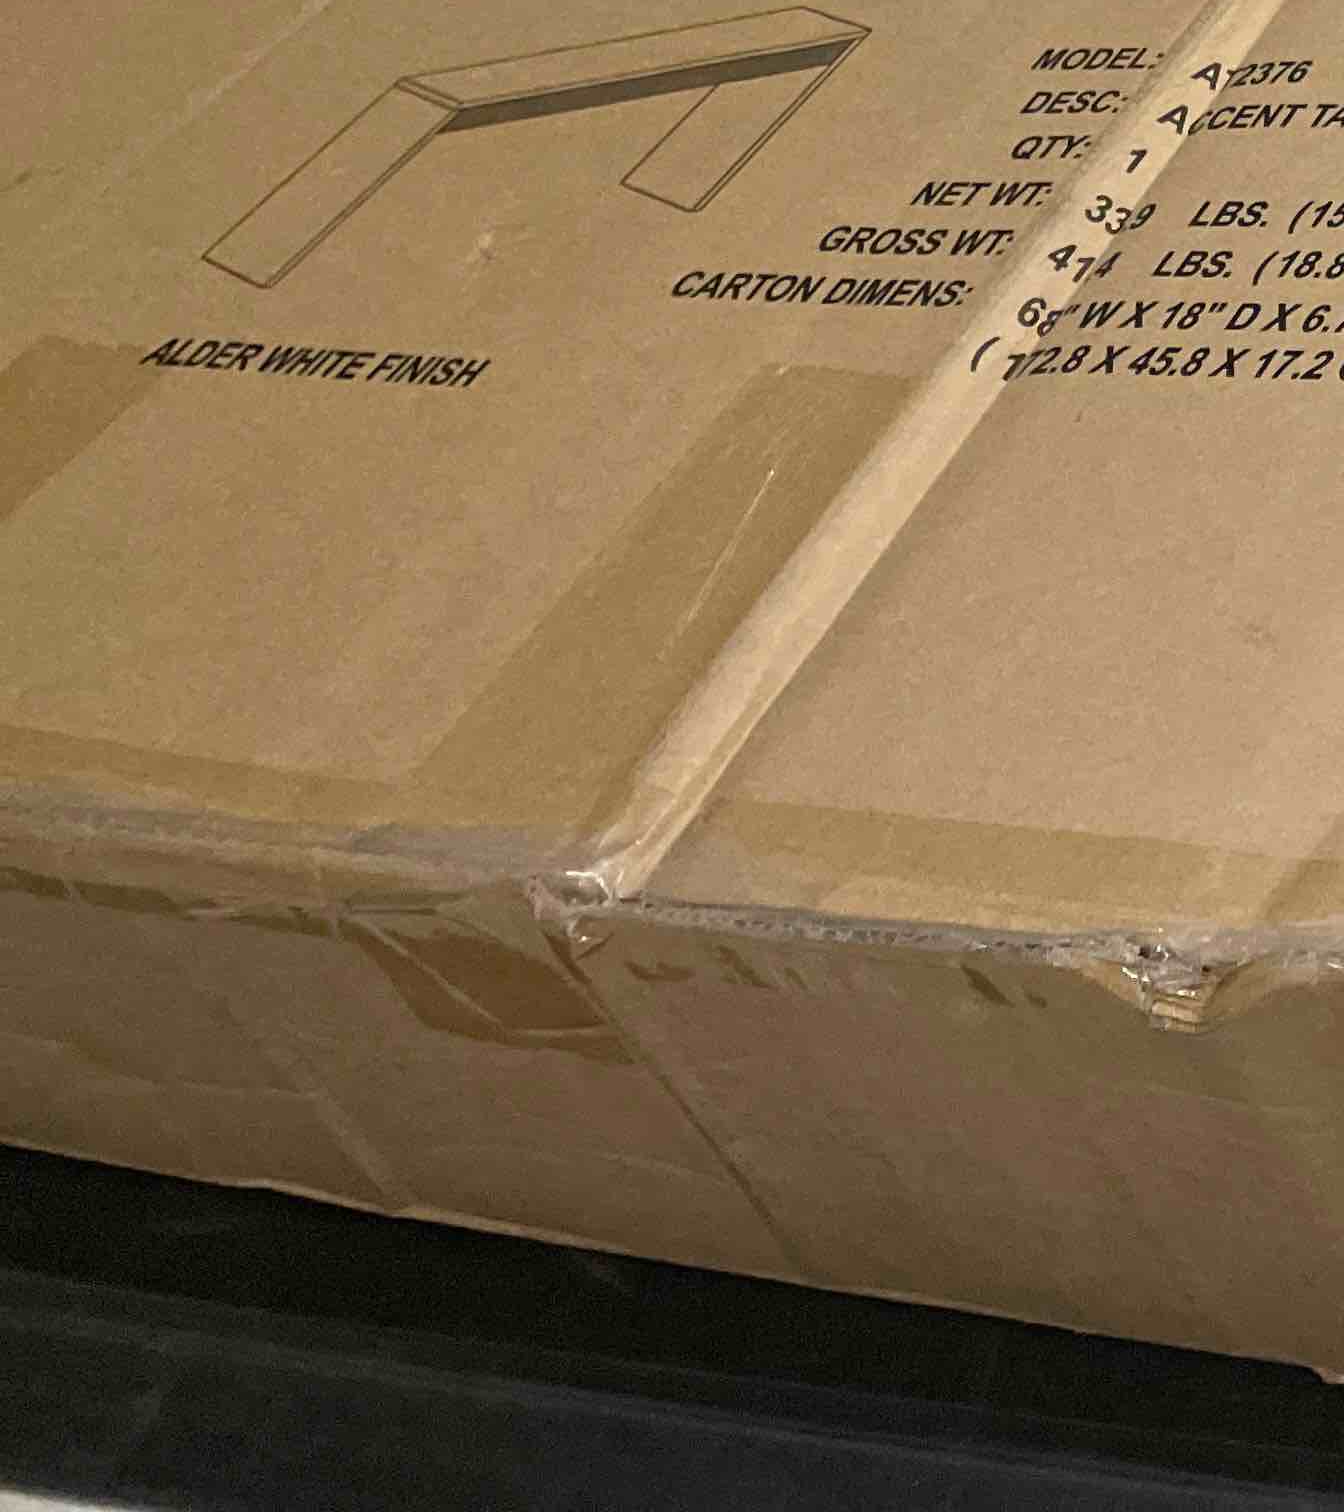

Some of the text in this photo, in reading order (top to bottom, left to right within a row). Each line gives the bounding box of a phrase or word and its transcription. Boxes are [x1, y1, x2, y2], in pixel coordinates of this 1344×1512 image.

[1031, 47, 1165, 71] MODEL:
[1020, 90, 1128, 114] DESC:
[1011, 135, 1147, 173] QTY: 1
[910, 182, 991, 207] NET
[988, 182, 1053, 207] WT:
[1188, 200, 1269, 228] LBS.
[818, 225, 948, 256] GROSS
[949, 229, 1016, 256] WT:
[1152, 251, 1234, 278] LBS.
[671, 270, 826, 303] CARTON
[822, 278, 974, 308] DIMENS:
[1079, 301, 1125, 328] W
[1119, 301, 1158, 328] X
[1162, 302, 1228, 330] 18"
[1224, 303, 1262, 330] D
[1260, 303, 1302, 332] X
[139, 338, 491, 387] ALDER WHITE FINISH
[1088, 345, 1131, 374] X
[1128, 346, 1210, 376] 45.8
[1207, 347, 1250, 377] X
[1254, 349, 1334, 380] 17.2
